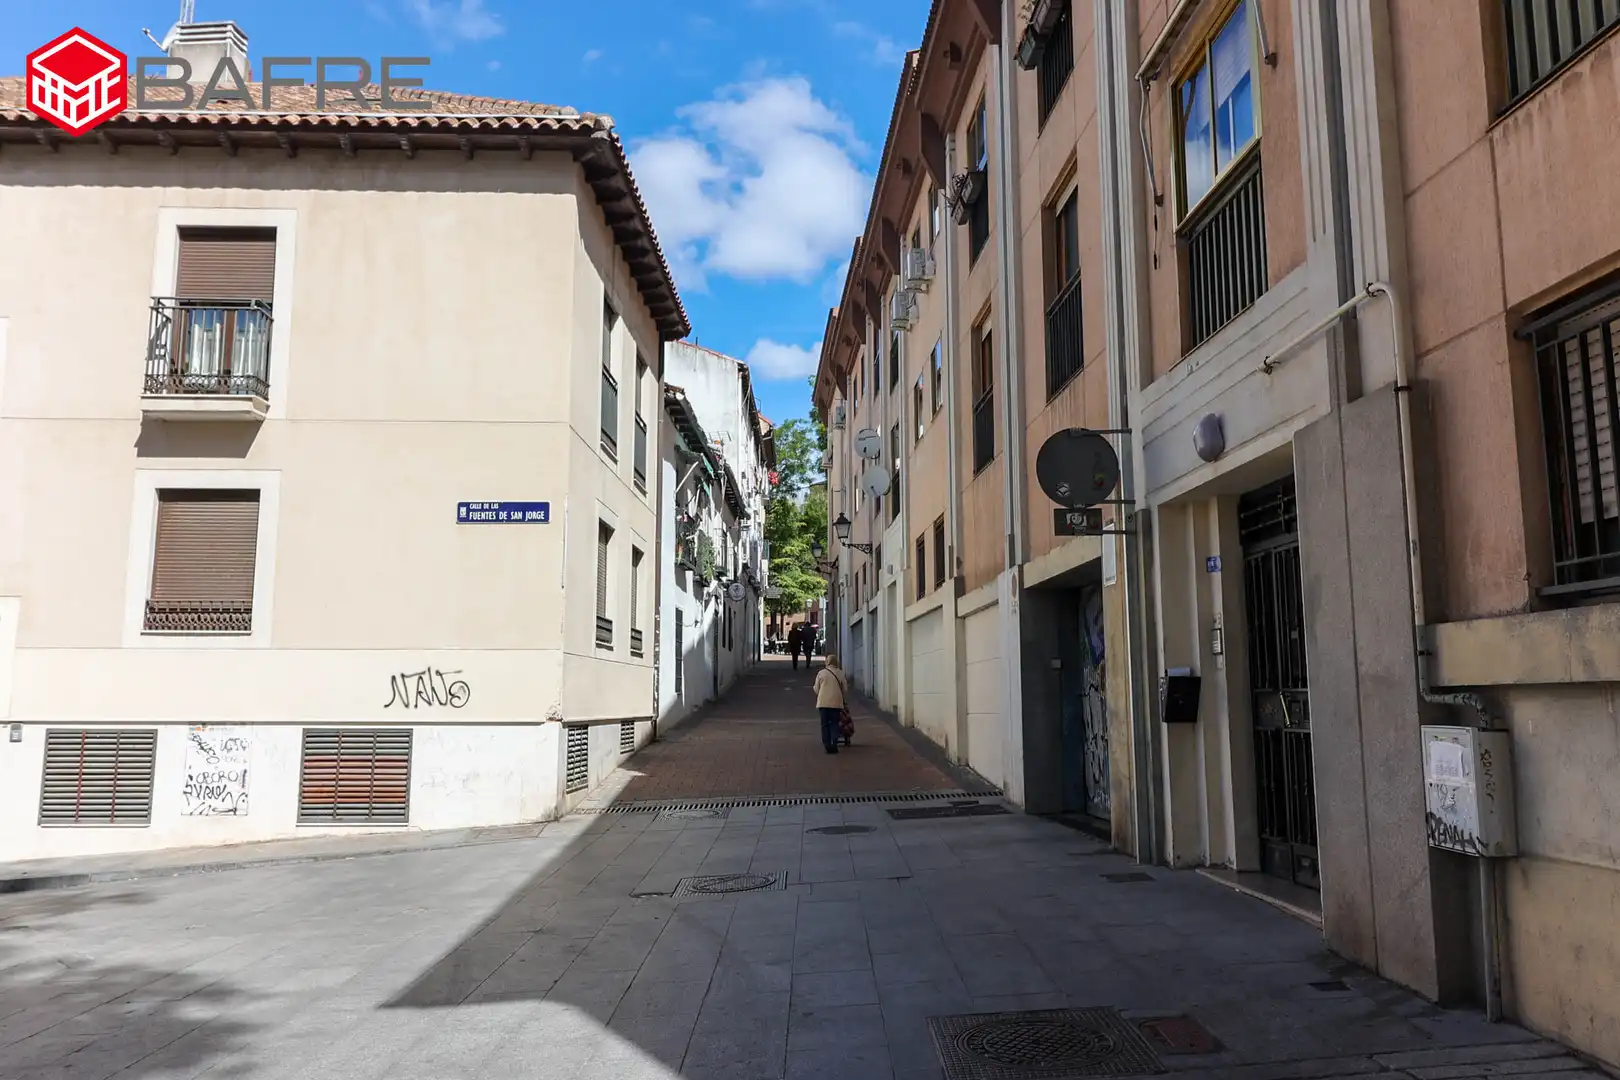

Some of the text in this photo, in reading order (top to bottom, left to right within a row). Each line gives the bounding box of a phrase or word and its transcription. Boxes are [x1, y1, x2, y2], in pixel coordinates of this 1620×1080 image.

[469, 510, 545, 521] FUENTES DE SAN JORGE
